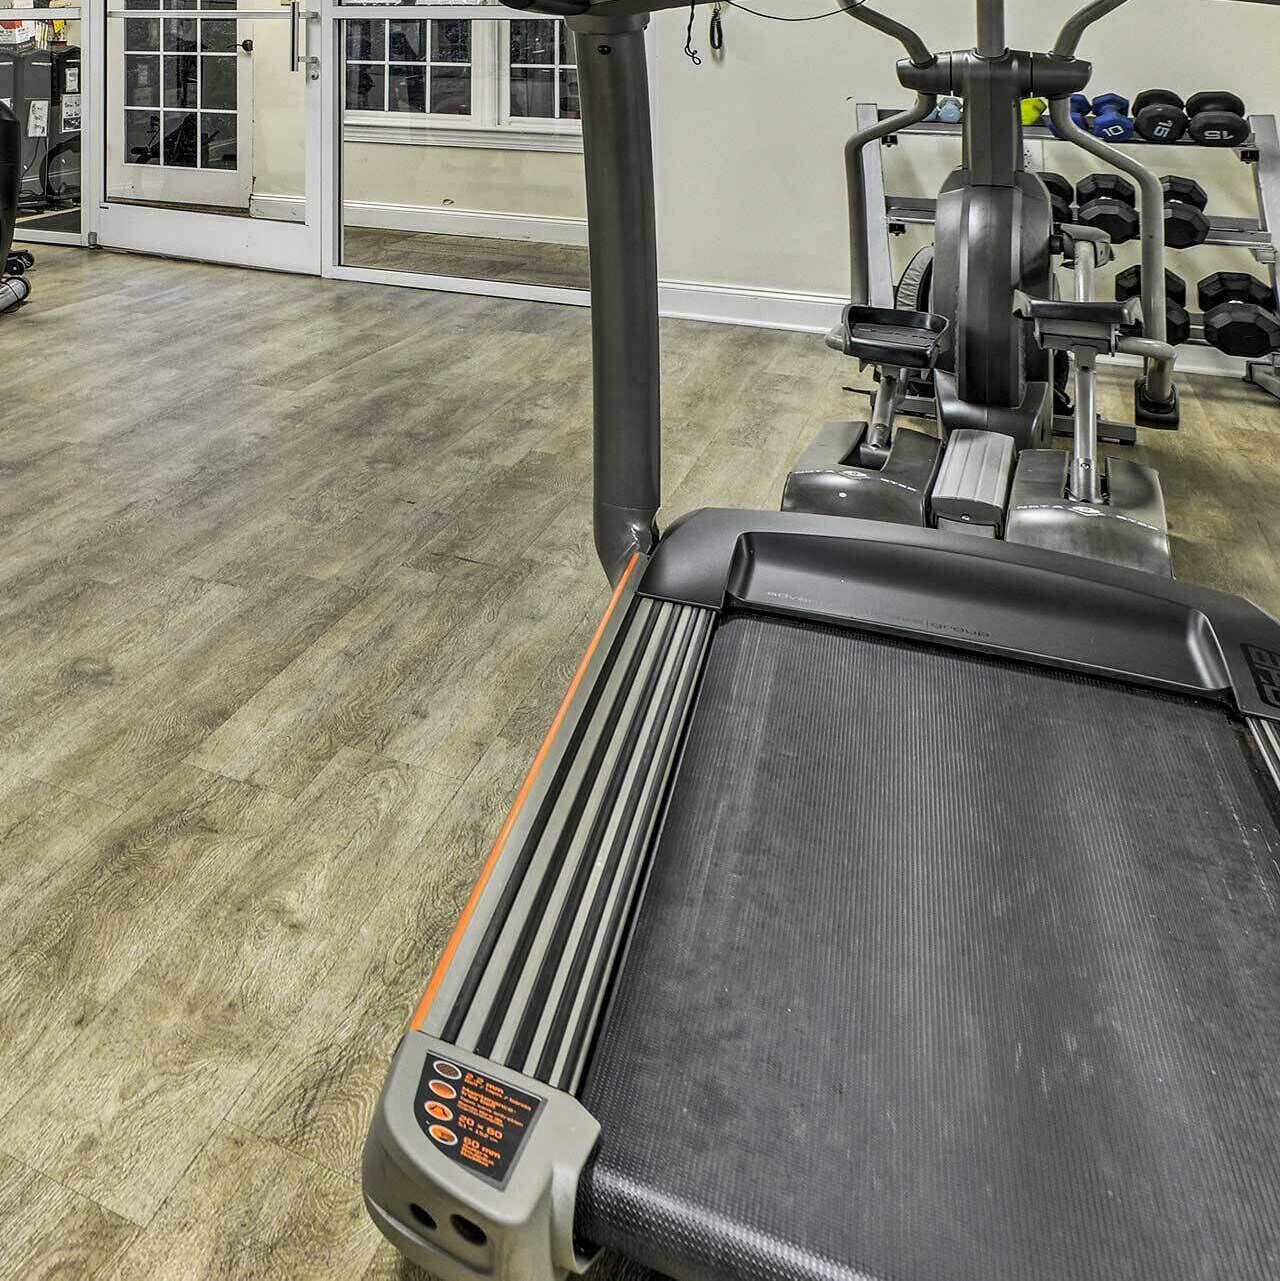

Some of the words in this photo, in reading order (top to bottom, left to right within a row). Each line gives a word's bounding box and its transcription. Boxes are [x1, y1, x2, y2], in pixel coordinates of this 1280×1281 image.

[1102, 125, 1125, 137] 10
[1153, 119, 1173, 138] 15
[1203, 129, 1235, 140] 15
[486, 1083, 504, 1094] mm
[458, 1115, 475, 1127] 20
[486, 1127, 503, 1140] 60
[463, 1137, 480, 1149] 60
[481, 1146, 501, 1160] mm
